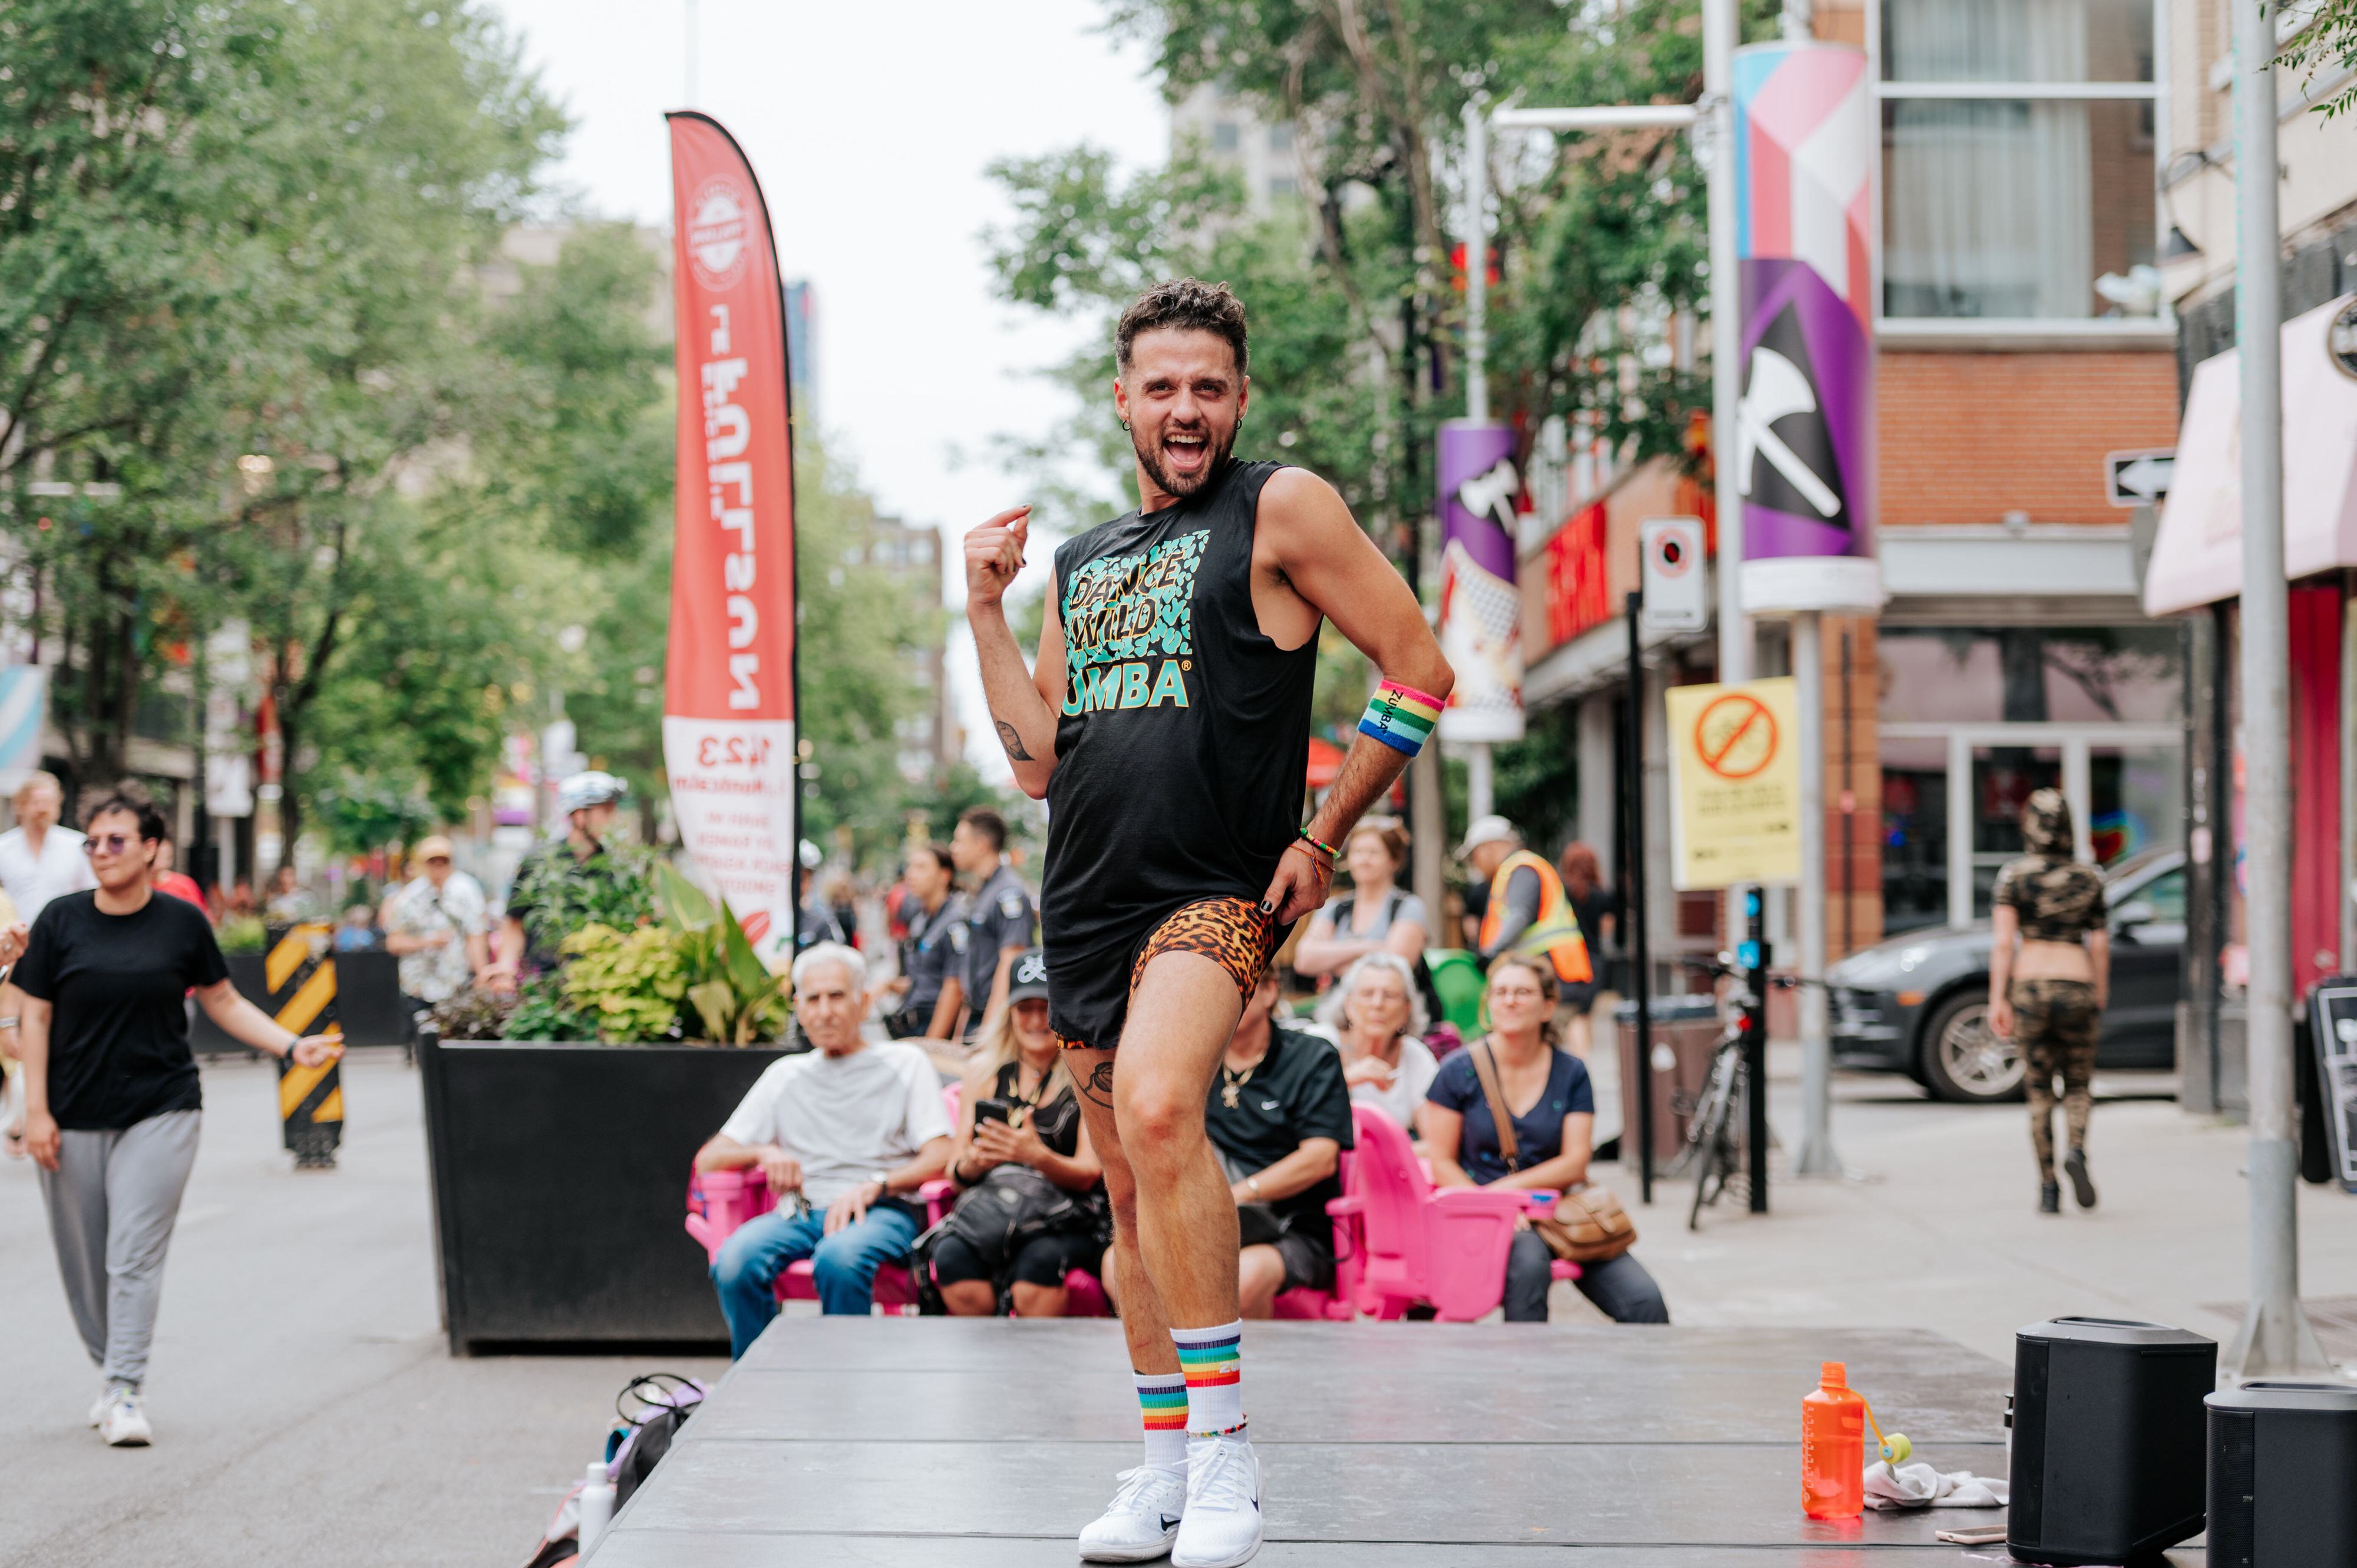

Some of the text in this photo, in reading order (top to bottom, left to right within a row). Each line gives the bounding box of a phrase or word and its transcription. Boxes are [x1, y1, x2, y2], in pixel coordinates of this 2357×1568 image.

[1069, 550, 1187, 611] DANCE
[1069, 597, 1158, 652] WILD
[1376, 689, 1404, 732] ZUMBA
